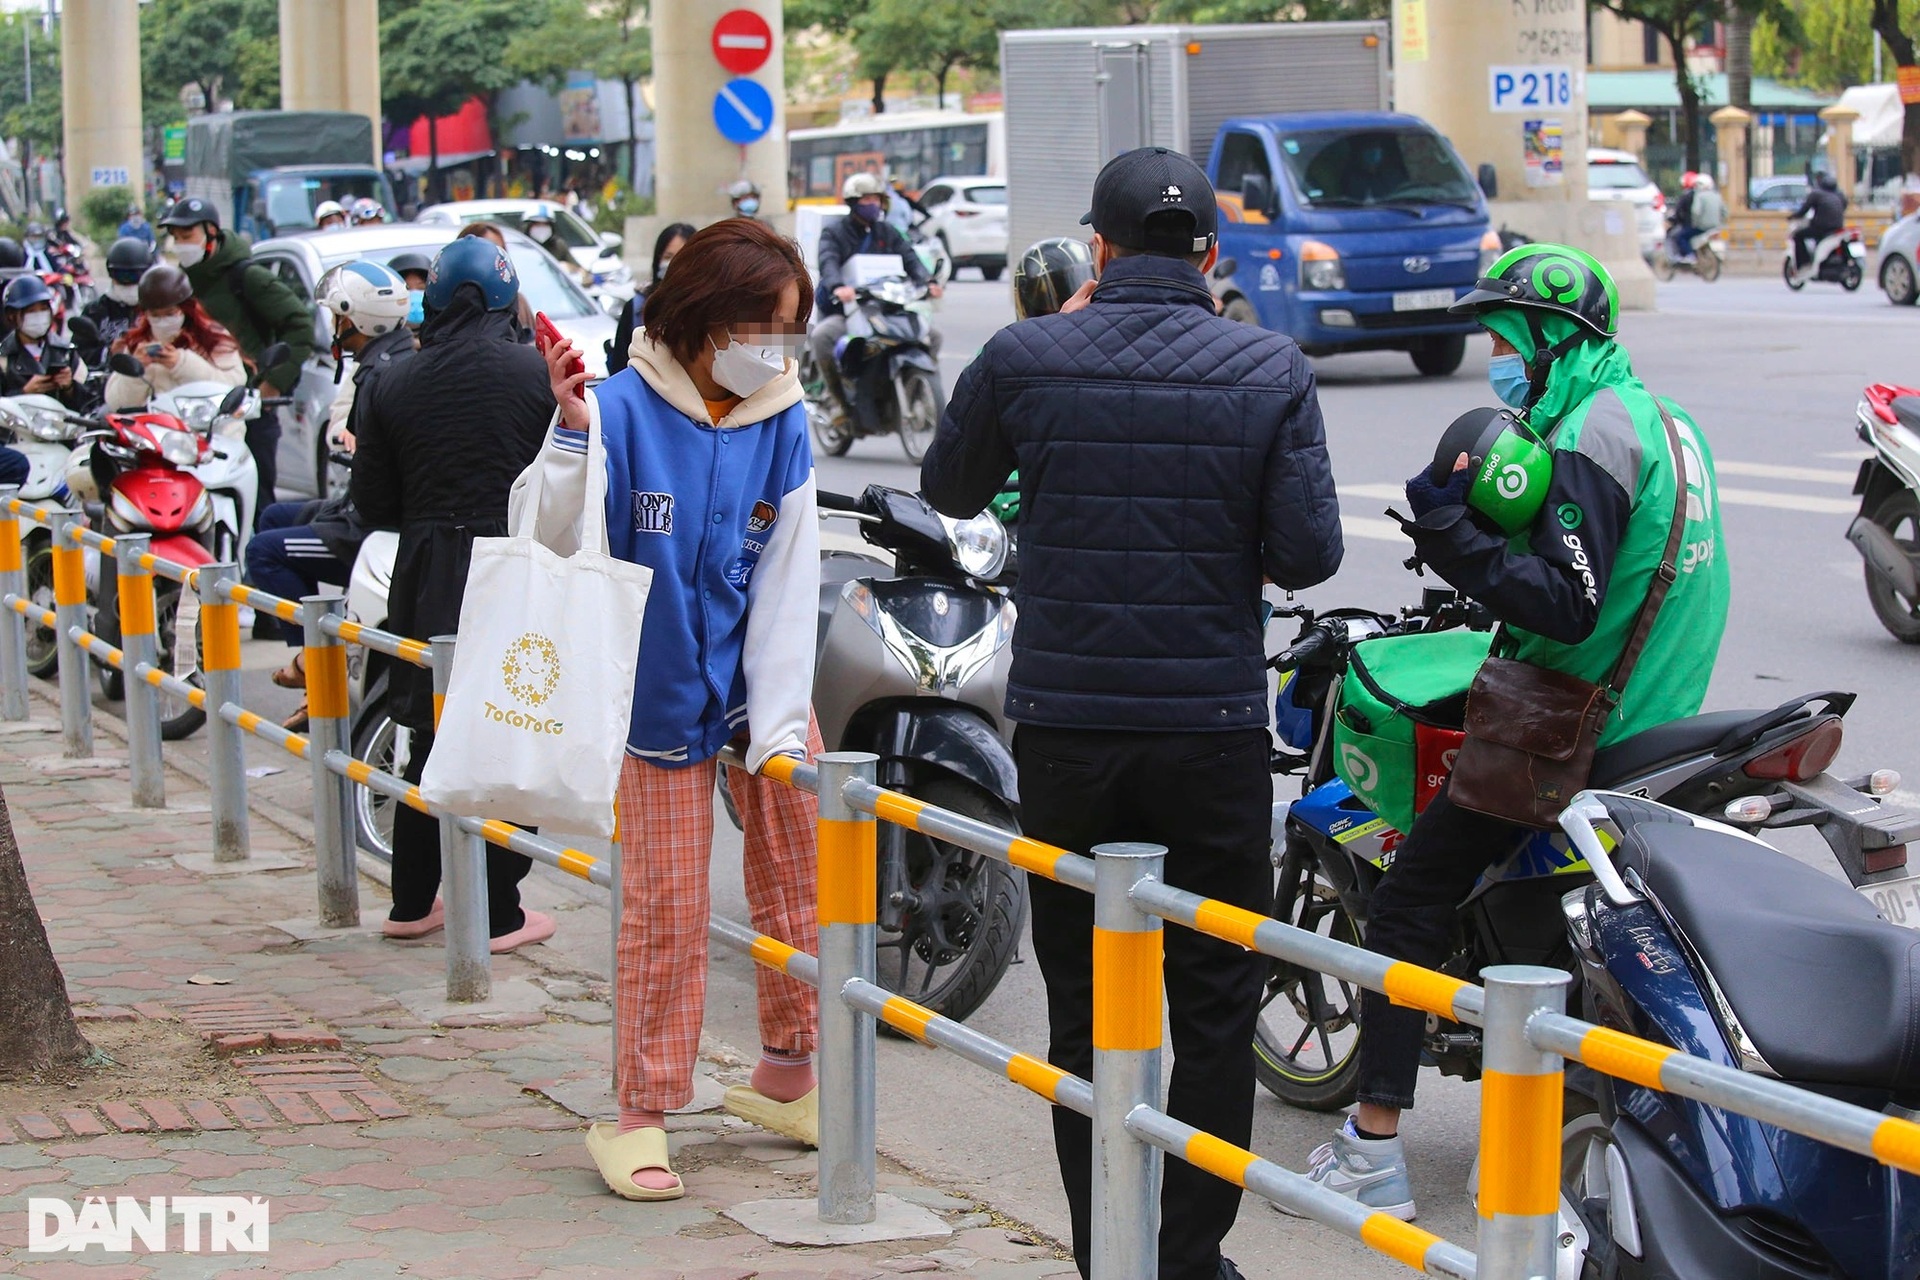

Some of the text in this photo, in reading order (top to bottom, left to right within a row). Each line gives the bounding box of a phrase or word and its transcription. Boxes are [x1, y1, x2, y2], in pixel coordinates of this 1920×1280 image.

[1481, 452, 1501, 484] gojek
[1562, 534, 1597, 606] gojek
[1629, 926, 1677, 974] Liberty
